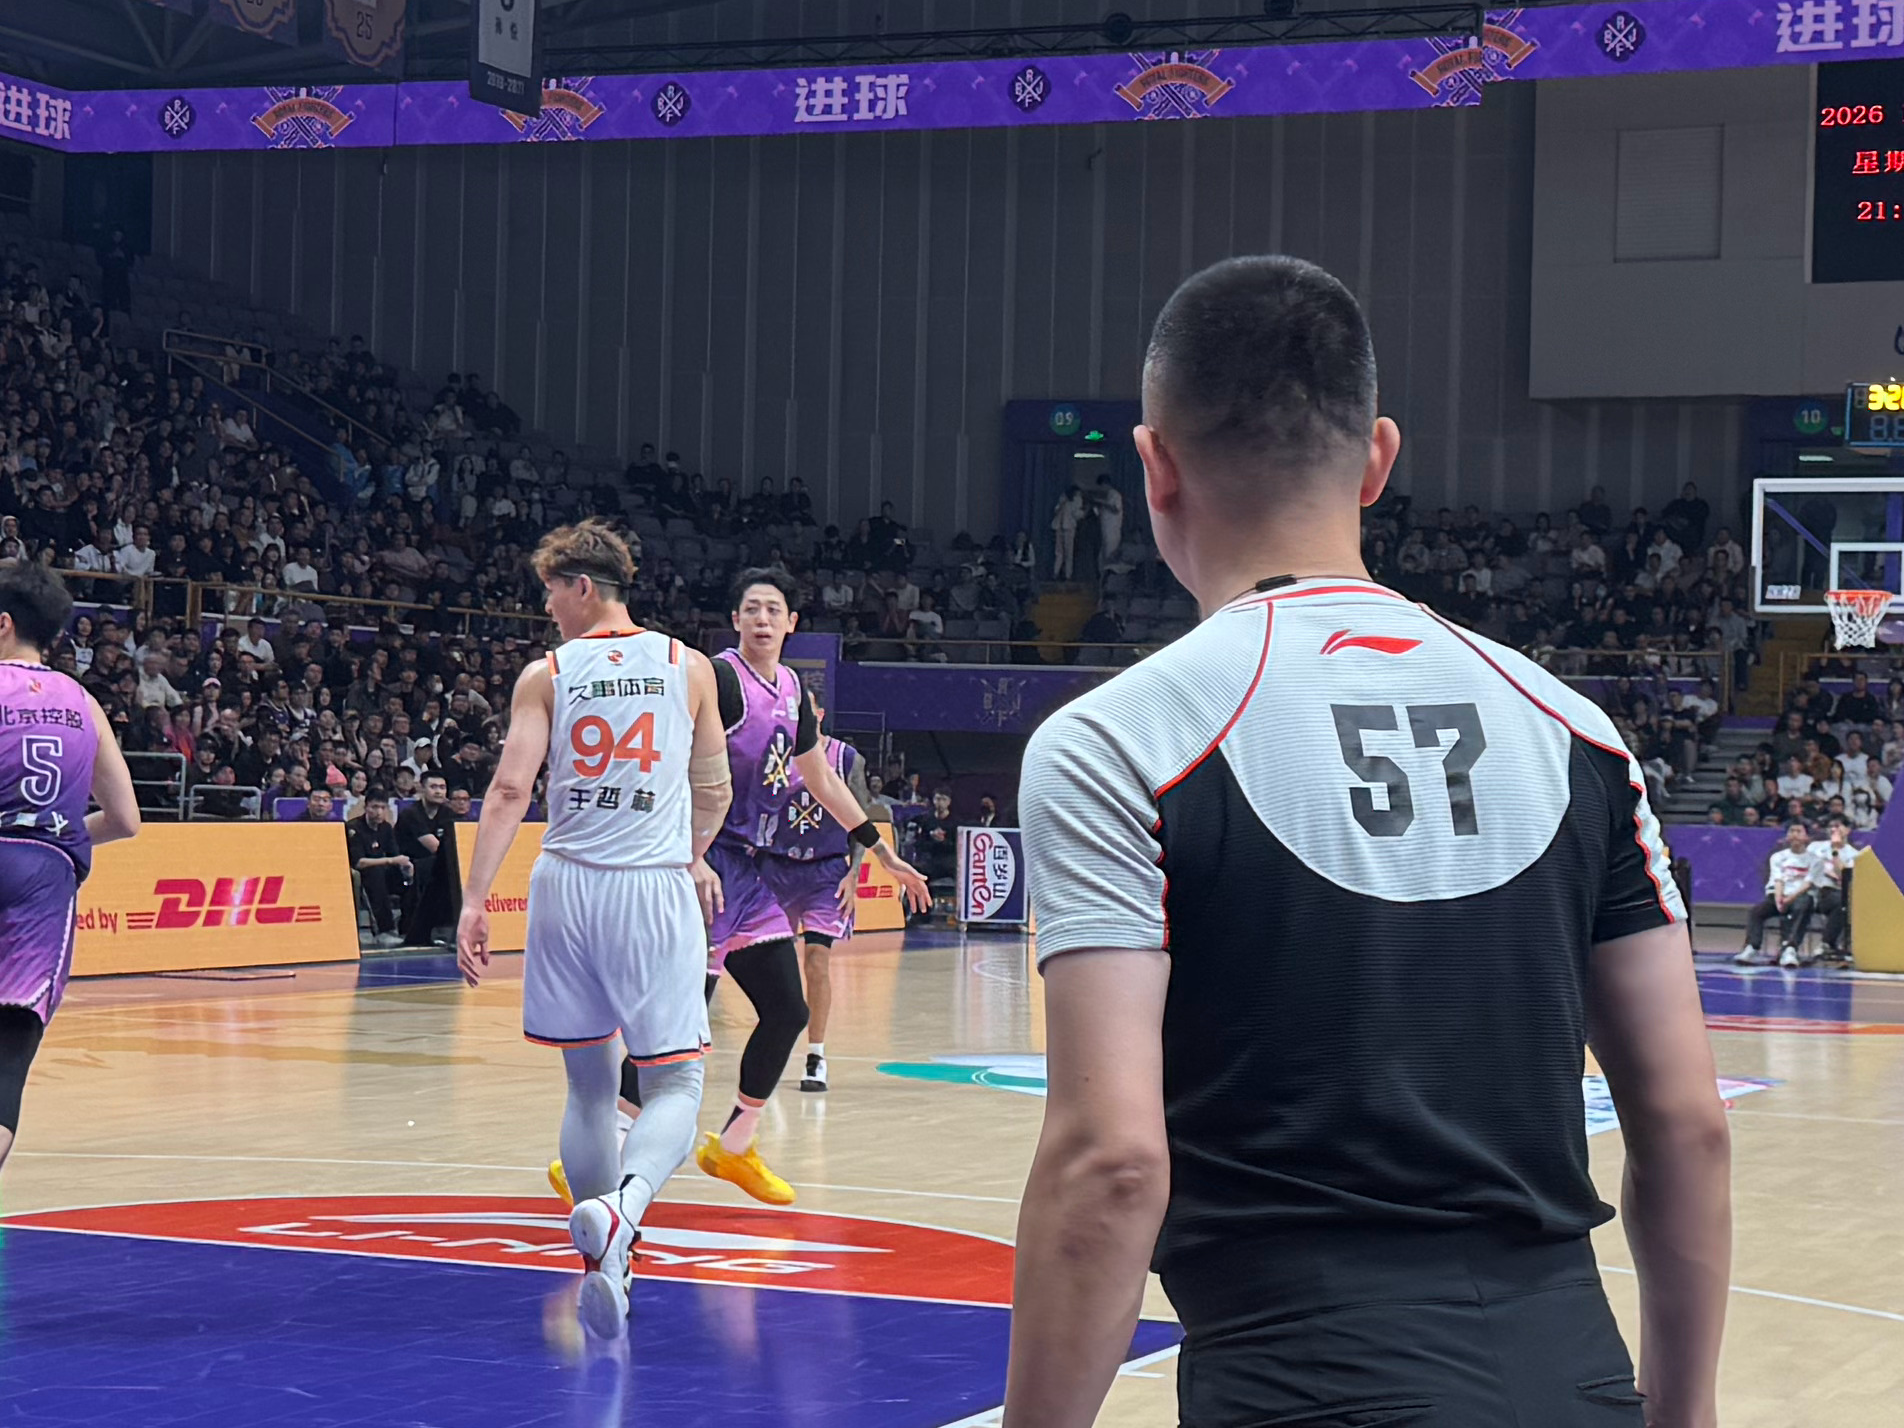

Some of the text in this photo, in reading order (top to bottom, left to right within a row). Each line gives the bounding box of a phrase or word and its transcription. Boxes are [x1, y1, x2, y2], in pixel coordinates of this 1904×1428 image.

[794, 74, 909, 124] 进球
[1820, 105, 1884, 127] 2026
[1801, 409, 1821, 424] 10
[20, 735, 63, 806] 5
[570, 712, 661, 778] 94
[1330, 702, 1486, 837] 57
[99, 909, 118, 935] by
[154, 875, 296, 929] DHL
